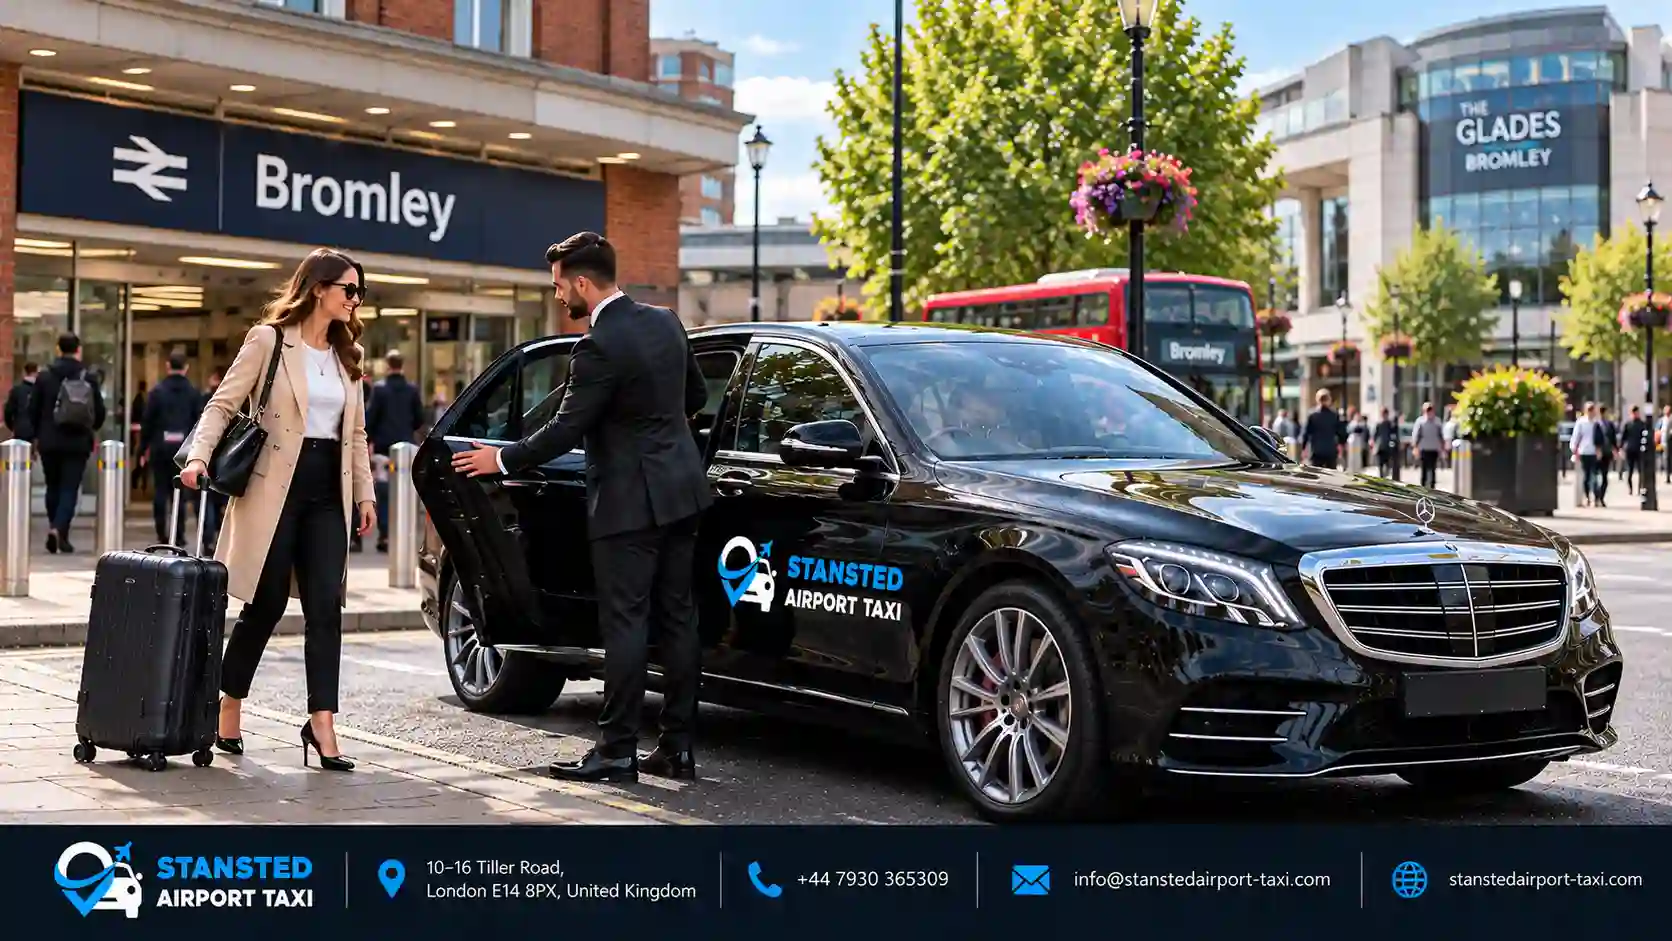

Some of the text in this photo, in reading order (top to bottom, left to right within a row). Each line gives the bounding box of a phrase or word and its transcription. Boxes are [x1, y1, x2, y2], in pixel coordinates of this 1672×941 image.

[1460, 100, 1489, 117] THE
[1456, 109, 1562, 146] GLADES
[1465, 147, 1552, 172] BROMLEY
[256, 153, 456, 243] Bromley
[1169, 341, 1226, 365] Bromley
[787, 554, 904, 592] STANSTED
[784, 587, 902, 621] AIRPORT TAXI
